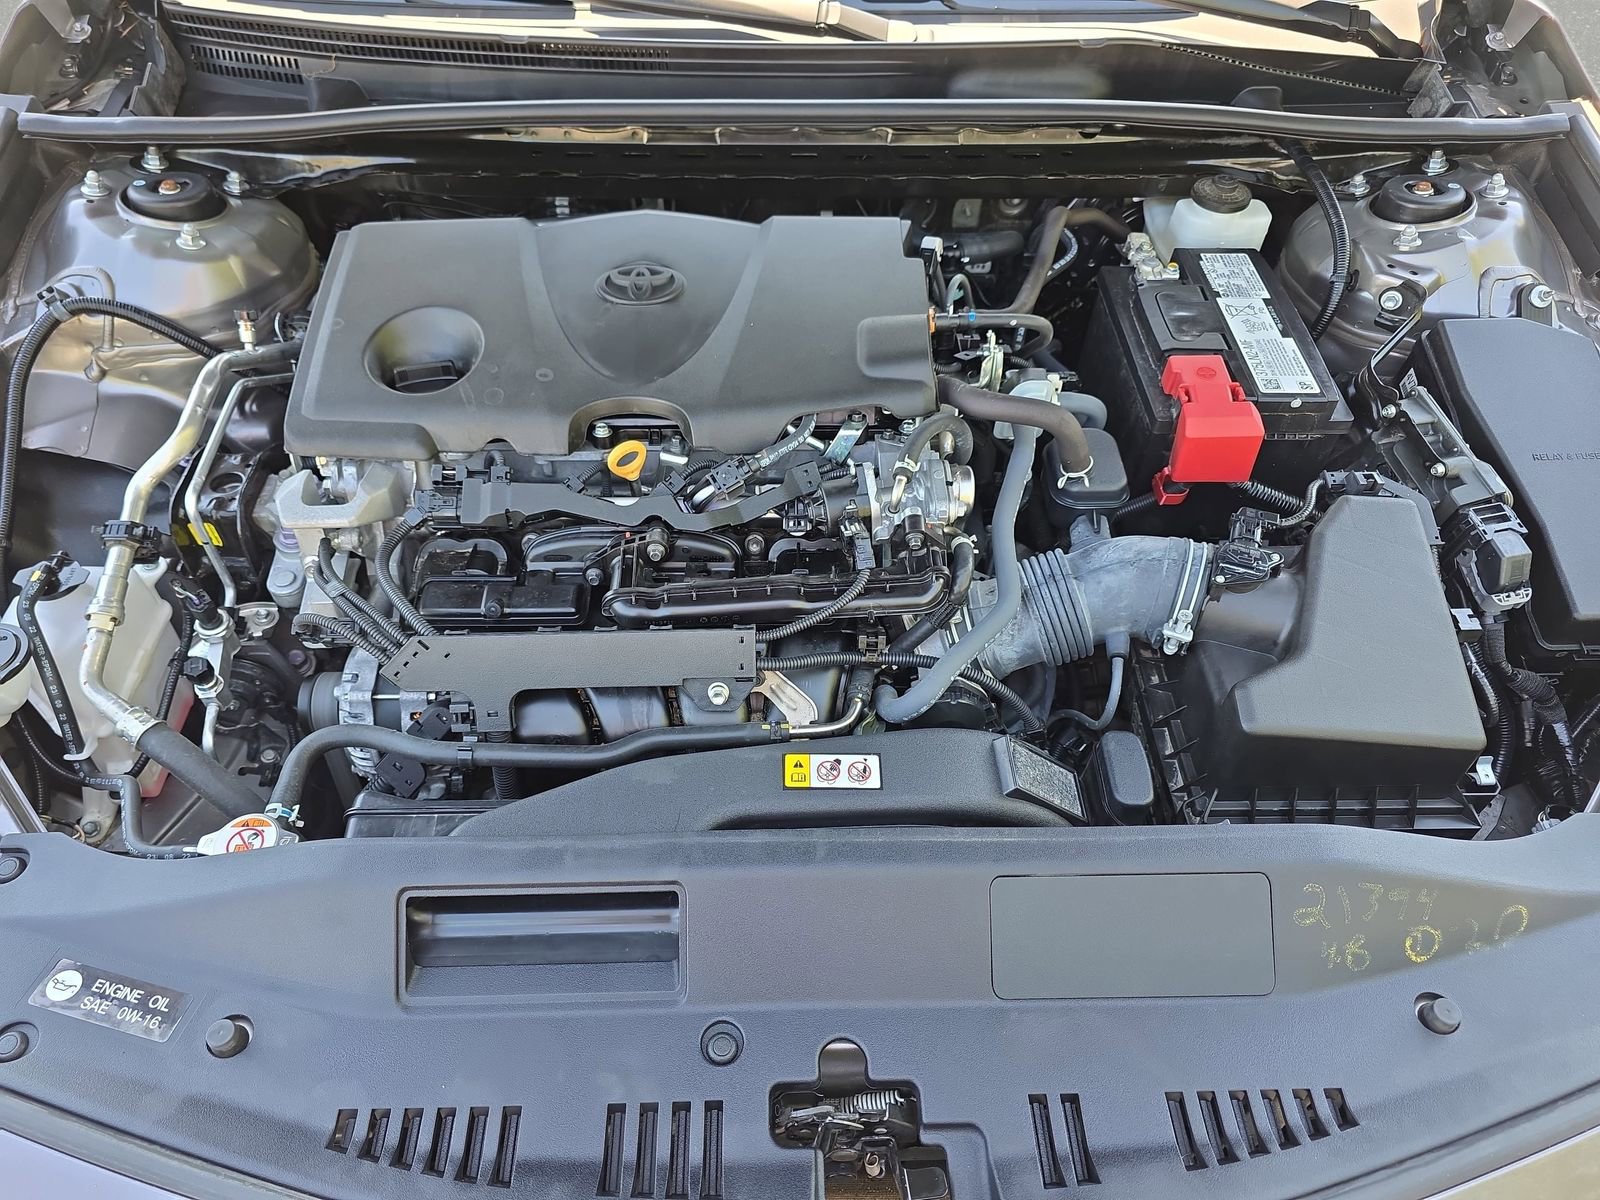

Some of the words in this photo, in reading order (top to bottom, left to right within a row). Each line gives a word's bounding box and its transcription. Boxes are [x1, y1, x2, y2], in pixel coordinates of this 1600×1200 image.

[1531, 452, 1564, 461] RELAY
[91, 978, 145, 1003] ENGINE
[148, 994, 170, 1012] OIL
[80, 996, 112, 1015] SAE
[116, 1006, 162, 1029] 0W-16
